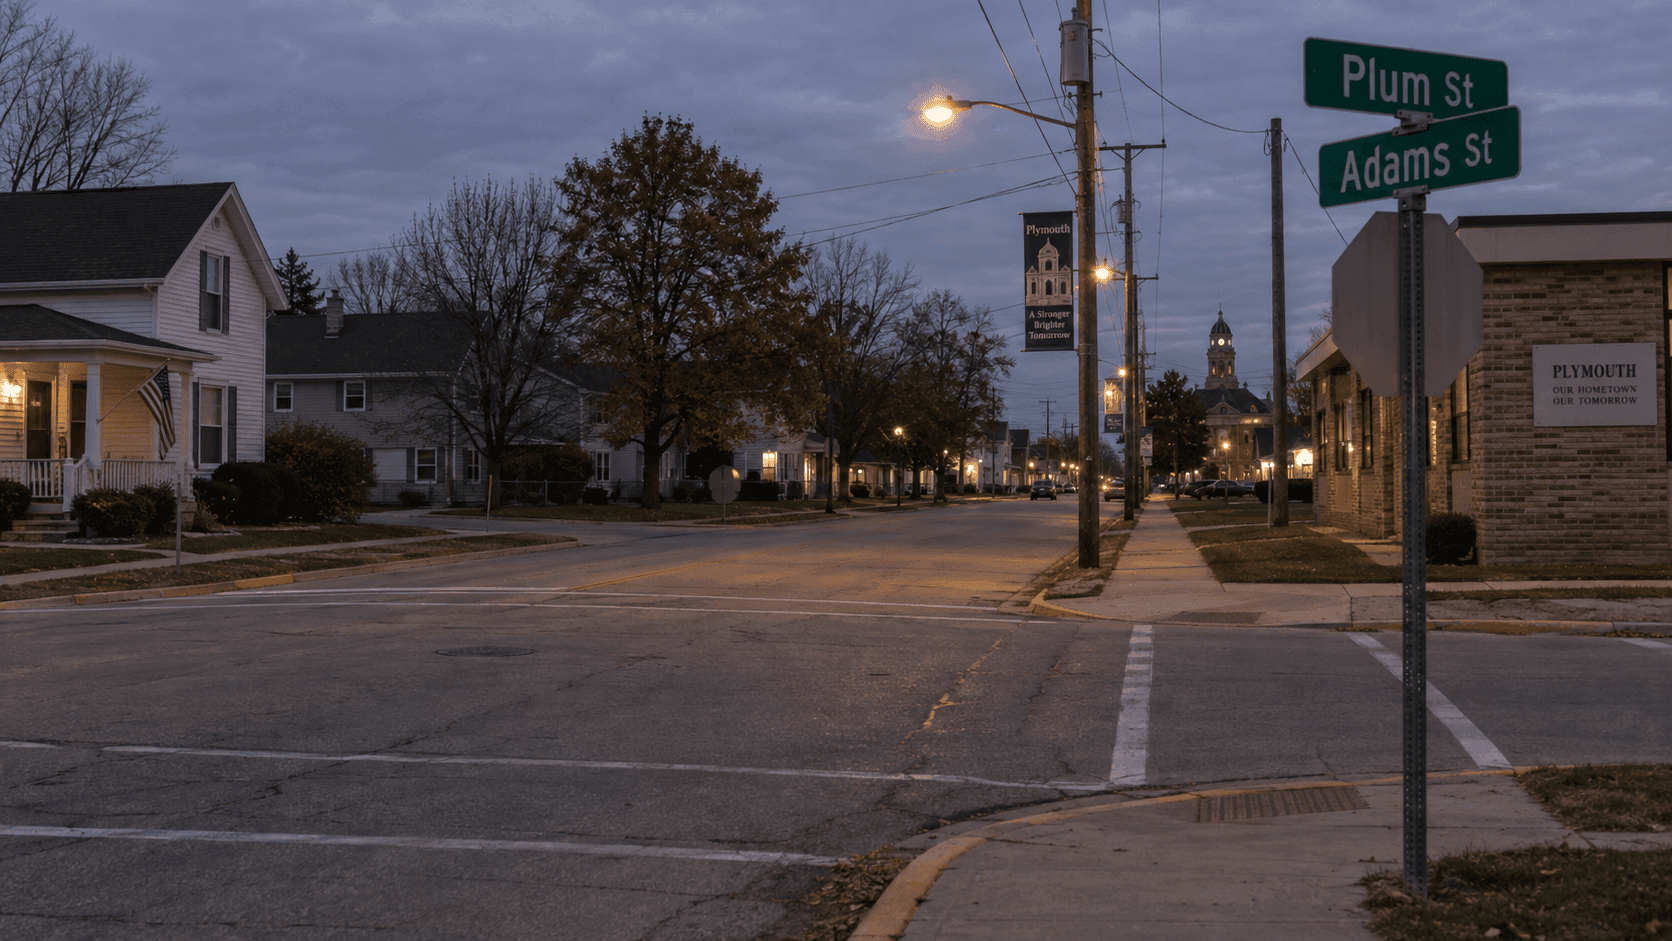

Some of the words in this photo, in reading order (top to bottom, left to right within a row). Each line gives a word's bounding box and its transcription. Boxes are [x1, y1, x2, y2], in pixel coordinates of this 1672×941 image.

[1343, 53, 1430, 106] Plum
[1444, 71, 1474, 109] St
[1340, 142, 1450, 193] Adams
[1464, 129, 1493, 167] St
[1026, 223, 1070, 237] Plymouth
[1028, 310, 1035, 319] A
[1028, 331, 1071, 340] Tomorrow
[1552, 363, 1637, 379] PLYMOUTH
[1552, 385, 1574, 395] OUR
[1577, 385, 1637, 394] HOMETOWN
[1552, 396, 1574, 405] OUR
[1578, 396, 1638, 405] TOMORROW
